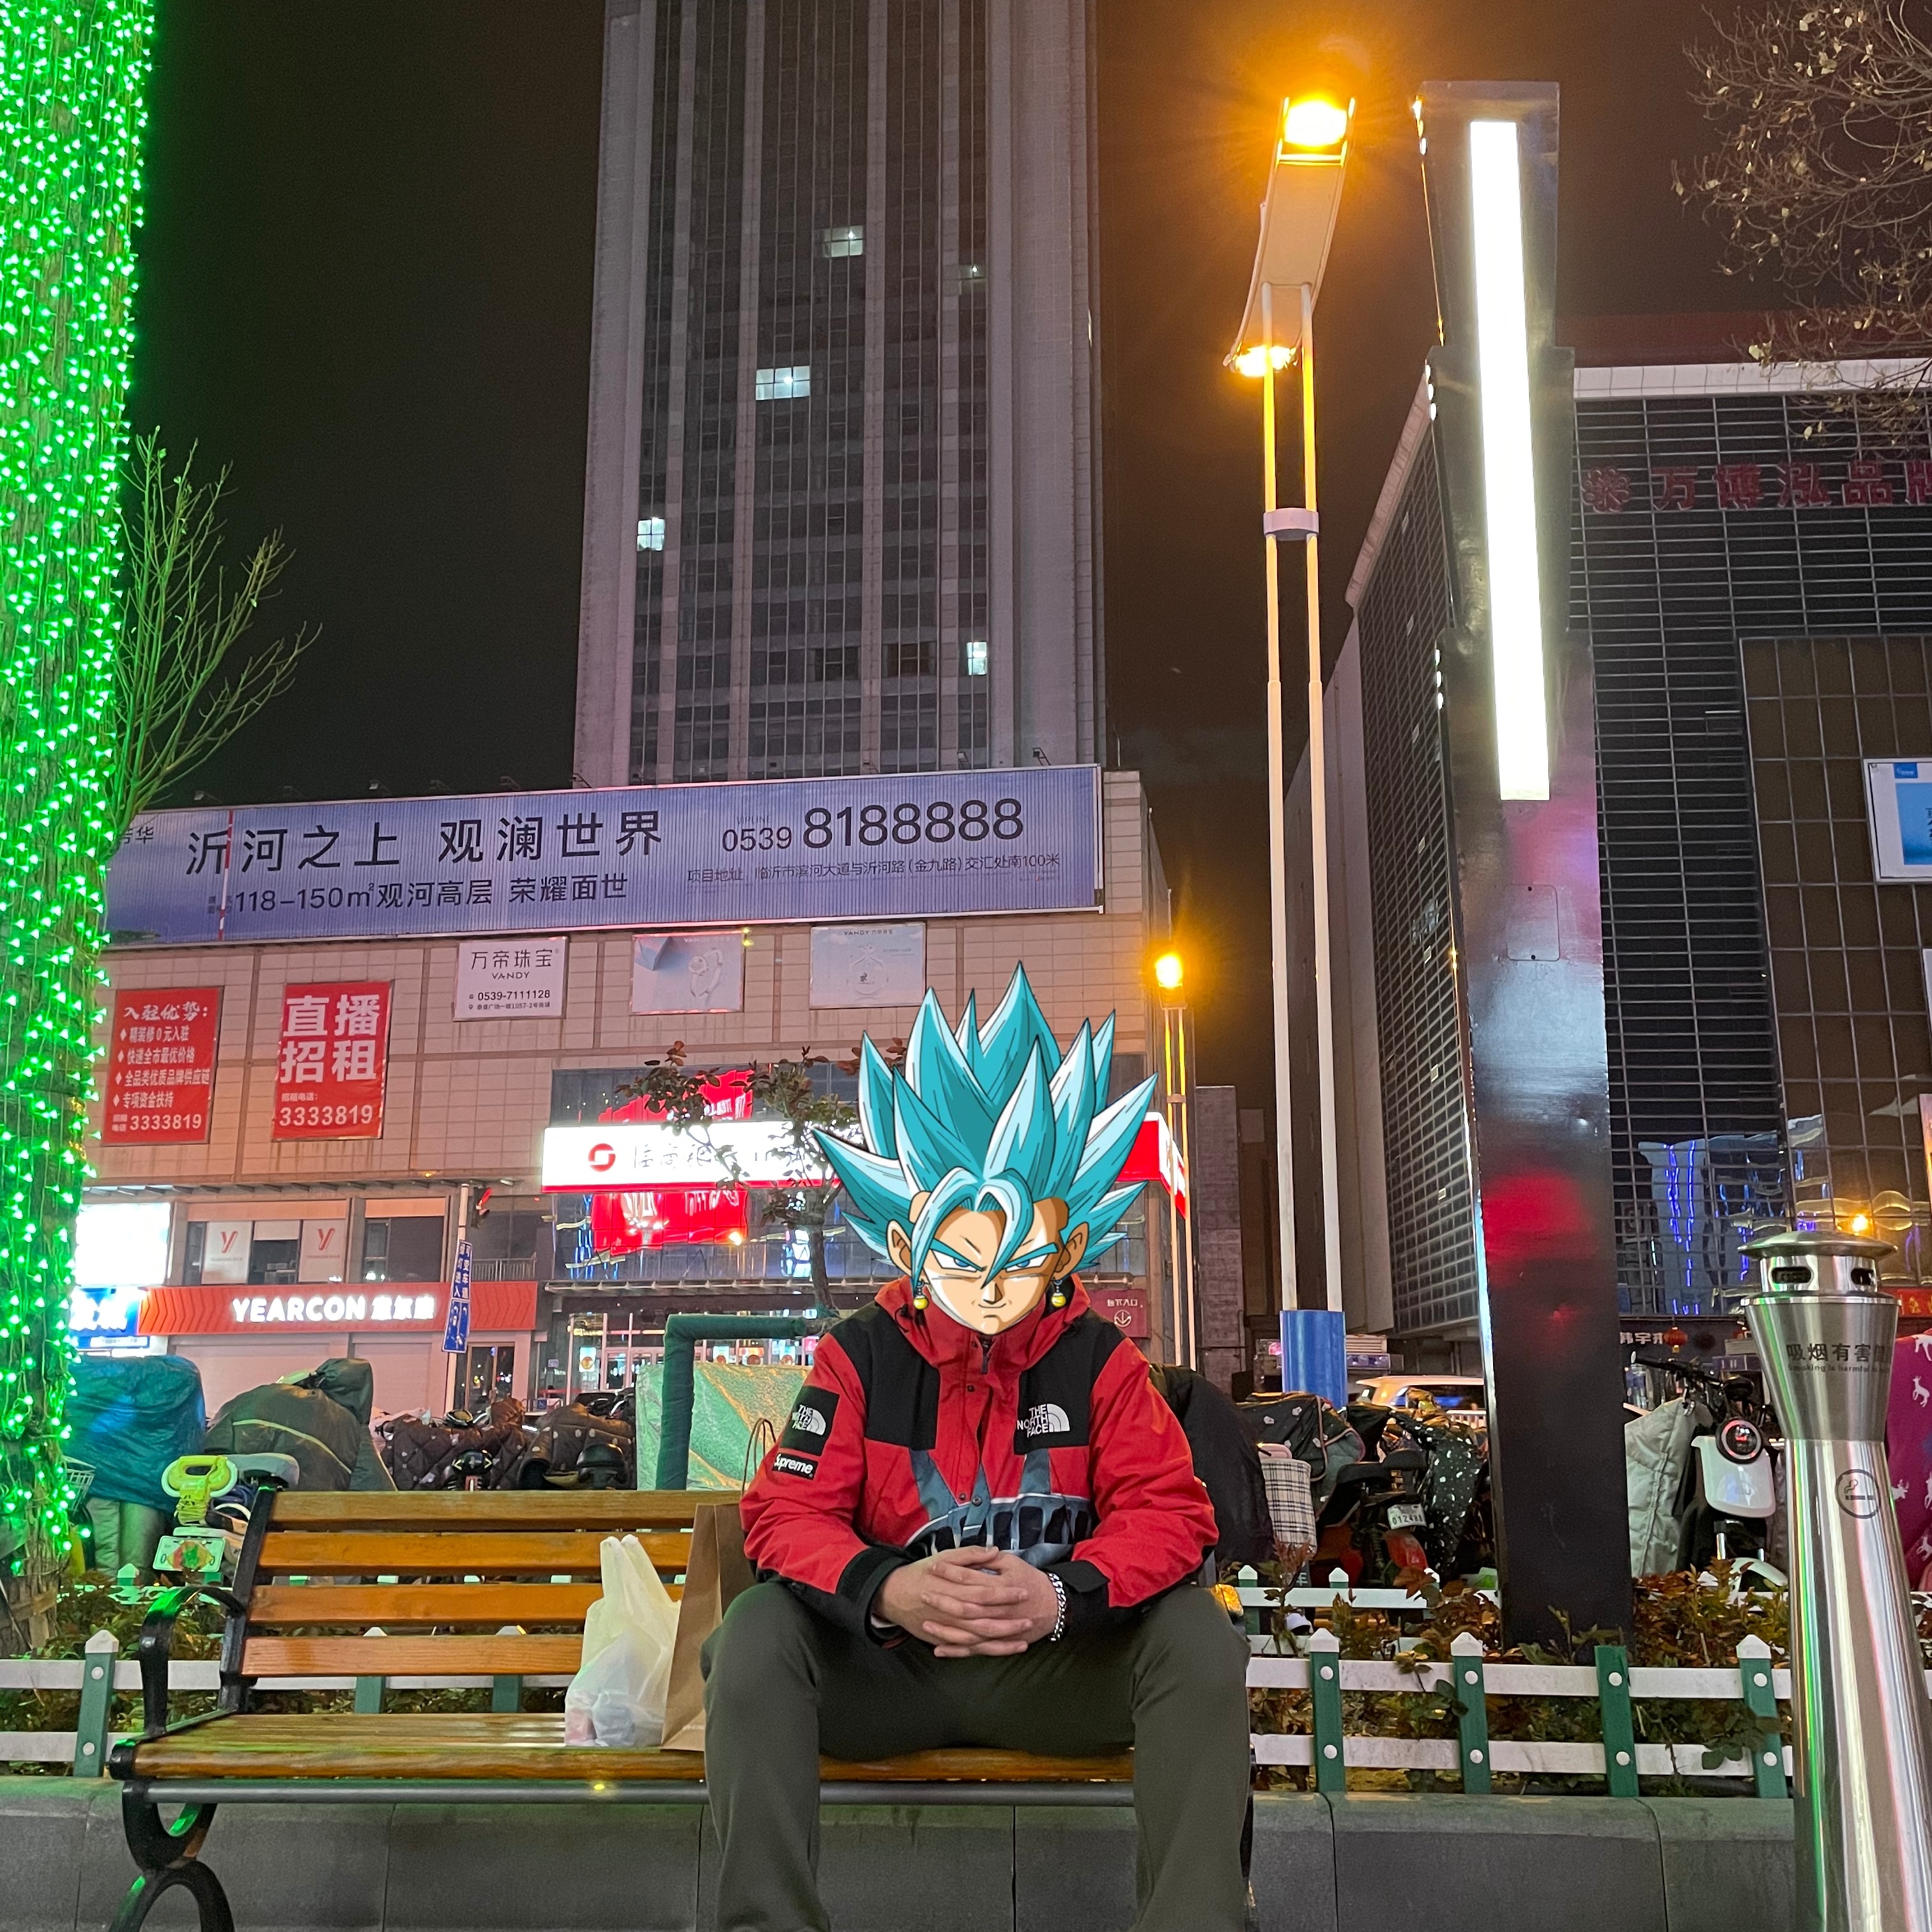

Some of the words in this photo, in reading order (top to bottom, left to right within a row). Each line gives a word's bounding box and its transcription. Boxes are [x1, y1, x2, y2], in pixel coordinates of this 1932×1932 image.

[723, 826, 792, 852] 0539
[803, 798, 1023, 848] 8188888
[187, 822, 399, 875] 沂河之上
[438, 810, 661, 863] 观澜世界
[509, 872, 627, 903] 荣耀面世
[471, 948, 553, 970] 万帝珠宝
[492, 971, 530, 980] VANDY
[478, 990, 550, 1001] 0539-7111128
[283, 994, 380, 1037] 直播
[280, 1039, 376, 1084] 招租
[123, 1091, 174, 1109] 专项资金扶持
[130, 1114, 202, 1131] 3333819
[279, 1104, 373, 1126] 3333819
[232, 1295, 366, 1322] YEARCON
[1016, 1413, 1048, 1430] NORTH
[1029, 1404, 1047, 1417] THE
[1027, 1423, 1049, 1438] FACE
